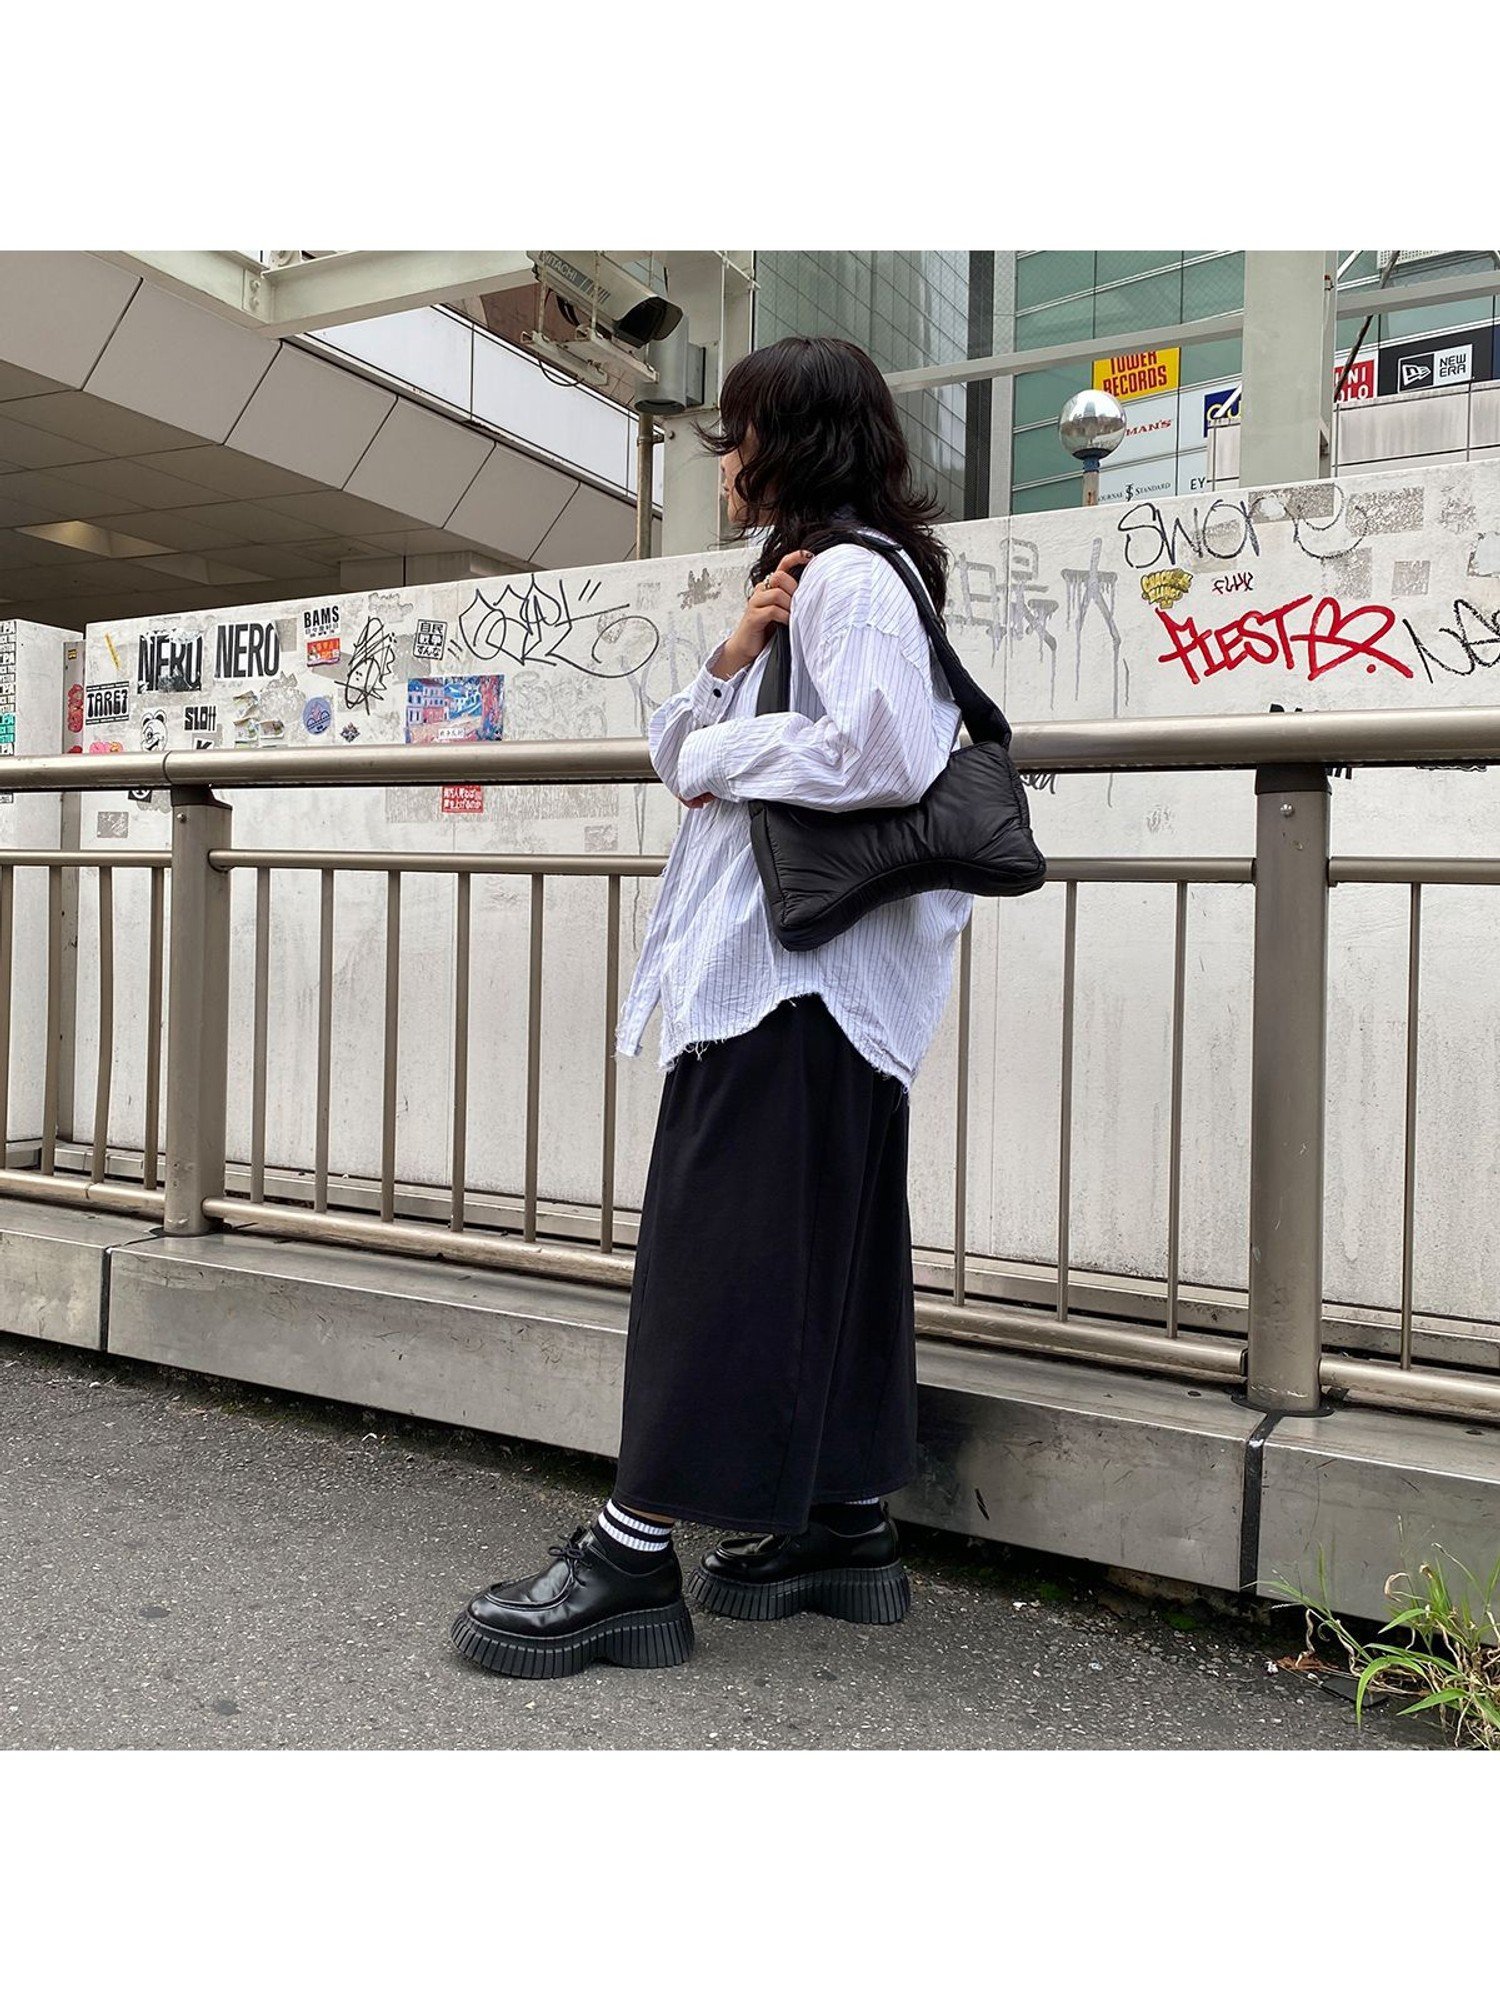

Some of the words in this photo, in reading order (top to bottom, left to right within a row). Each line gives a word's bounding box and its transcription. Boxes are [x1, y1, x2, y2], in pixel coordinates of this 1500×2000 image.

[1439, 353, 1466, 367] NEW
[1439, 364, 1466, 377] ERA
[1103, 364, 1168, 396] RECORDS
[304, 606, 339, 628] BAMS
[214, 623, 280, 678] NERO
